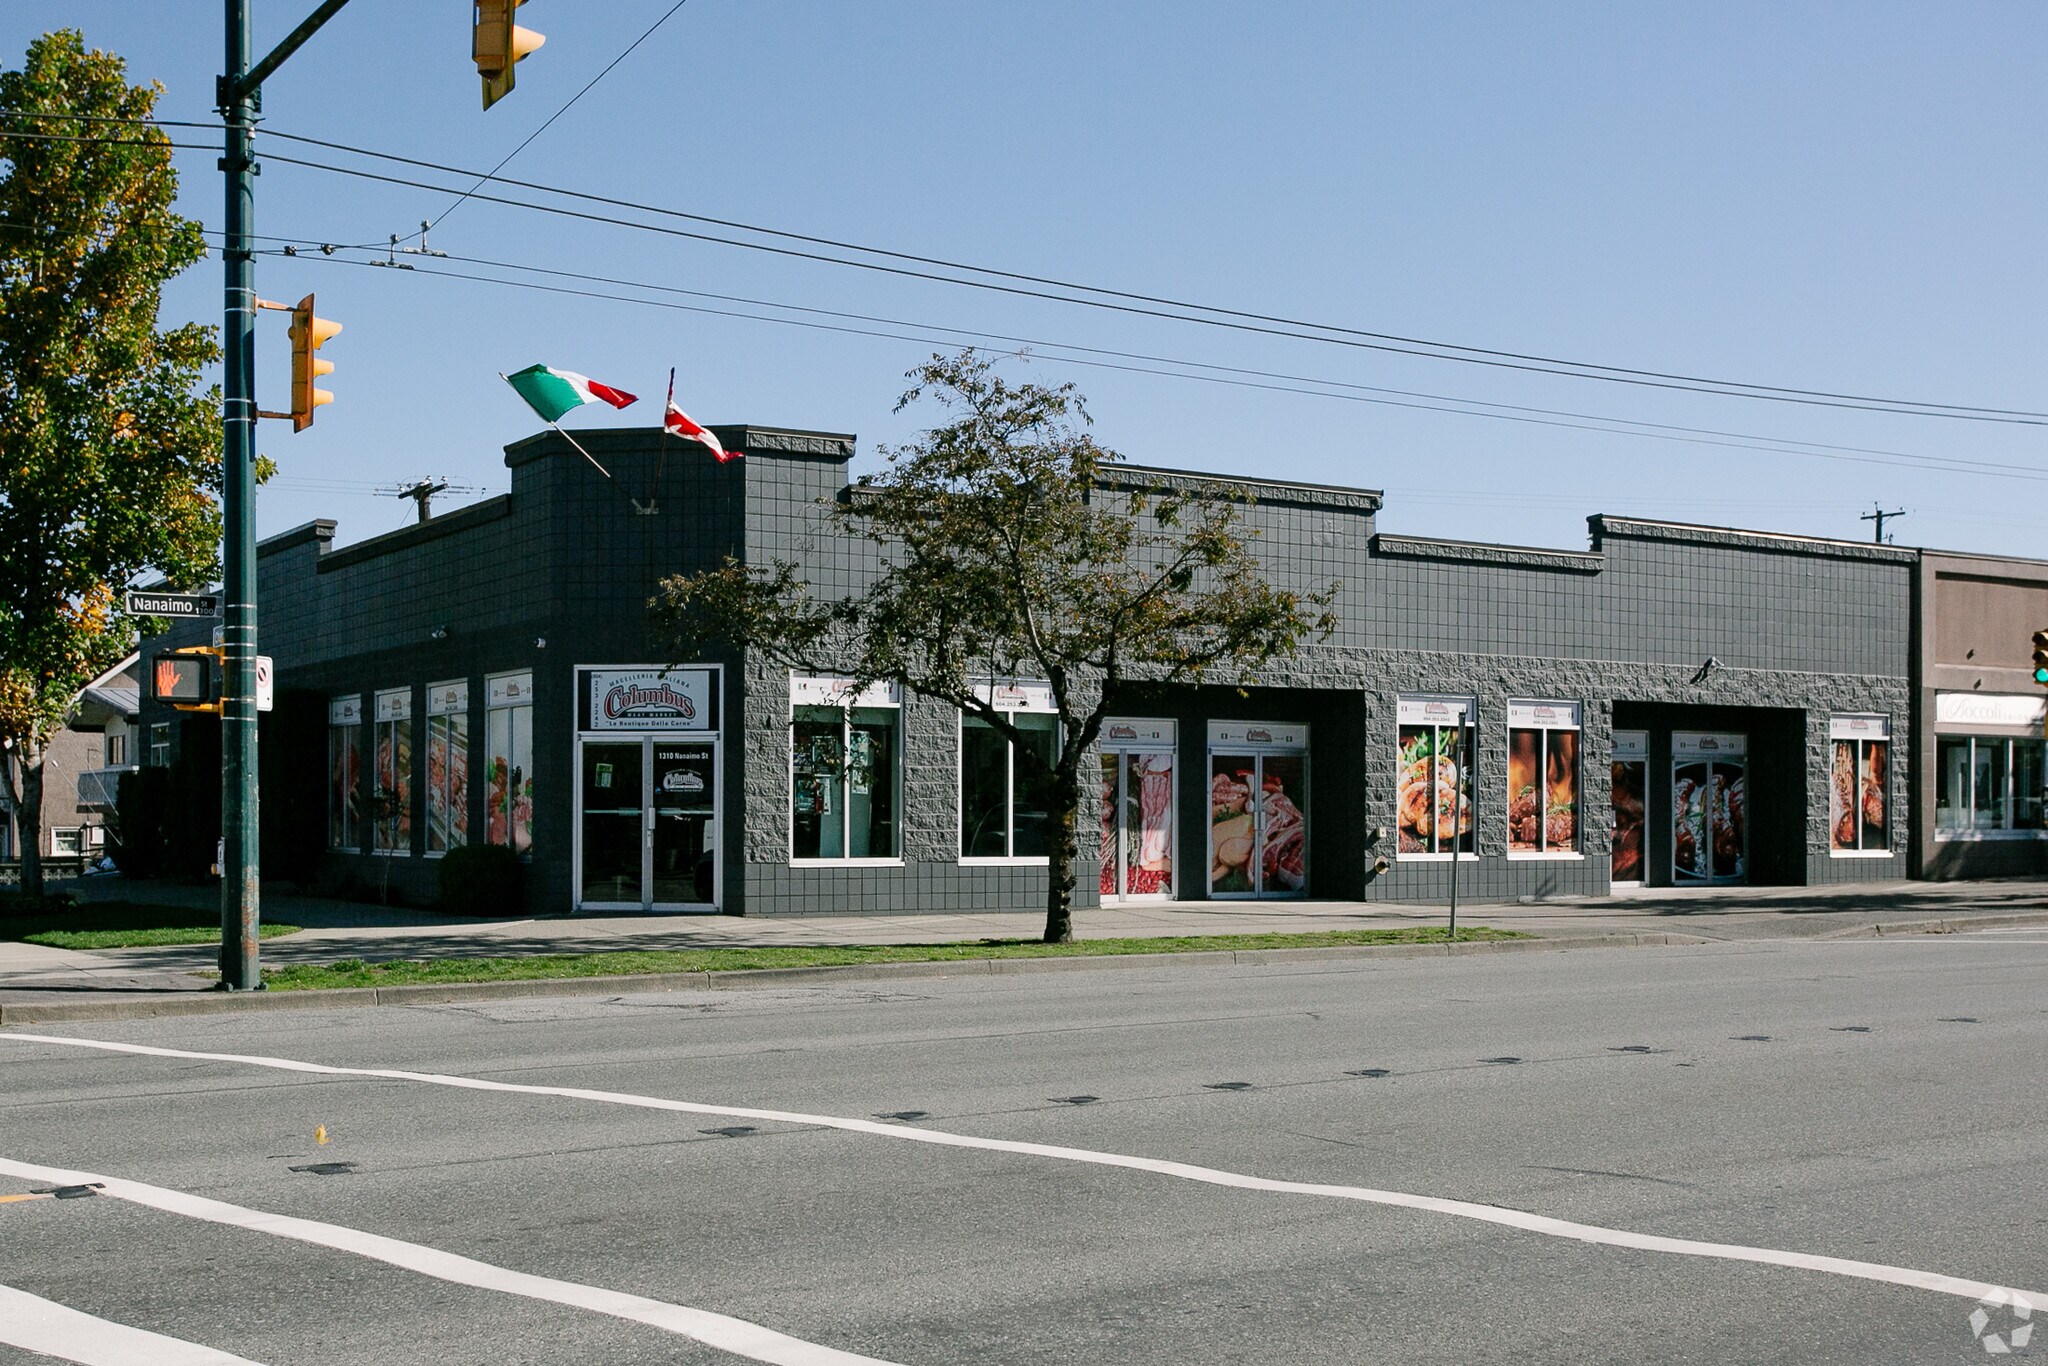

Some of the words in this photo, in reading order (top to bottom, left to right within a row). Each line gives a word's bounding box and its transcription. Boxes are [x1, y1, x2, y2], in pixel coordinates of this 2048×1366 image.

[134, 597, 193, 613] Nanaimo
[200, 600, 208, 608] St
[609, 673, 654, 687] MACELLERIA
[657, 673, 690, 688] ALIANA
[604, 684, 696, 720] Columbus
[1945, 698, 2002, 720] Boccoli
[619, 720, 649, 728] Boutique
[659, 752, 674, 760] 1310
[674, 751, 701, 760] Nanaimo
[701, 752, 709, 760] St
